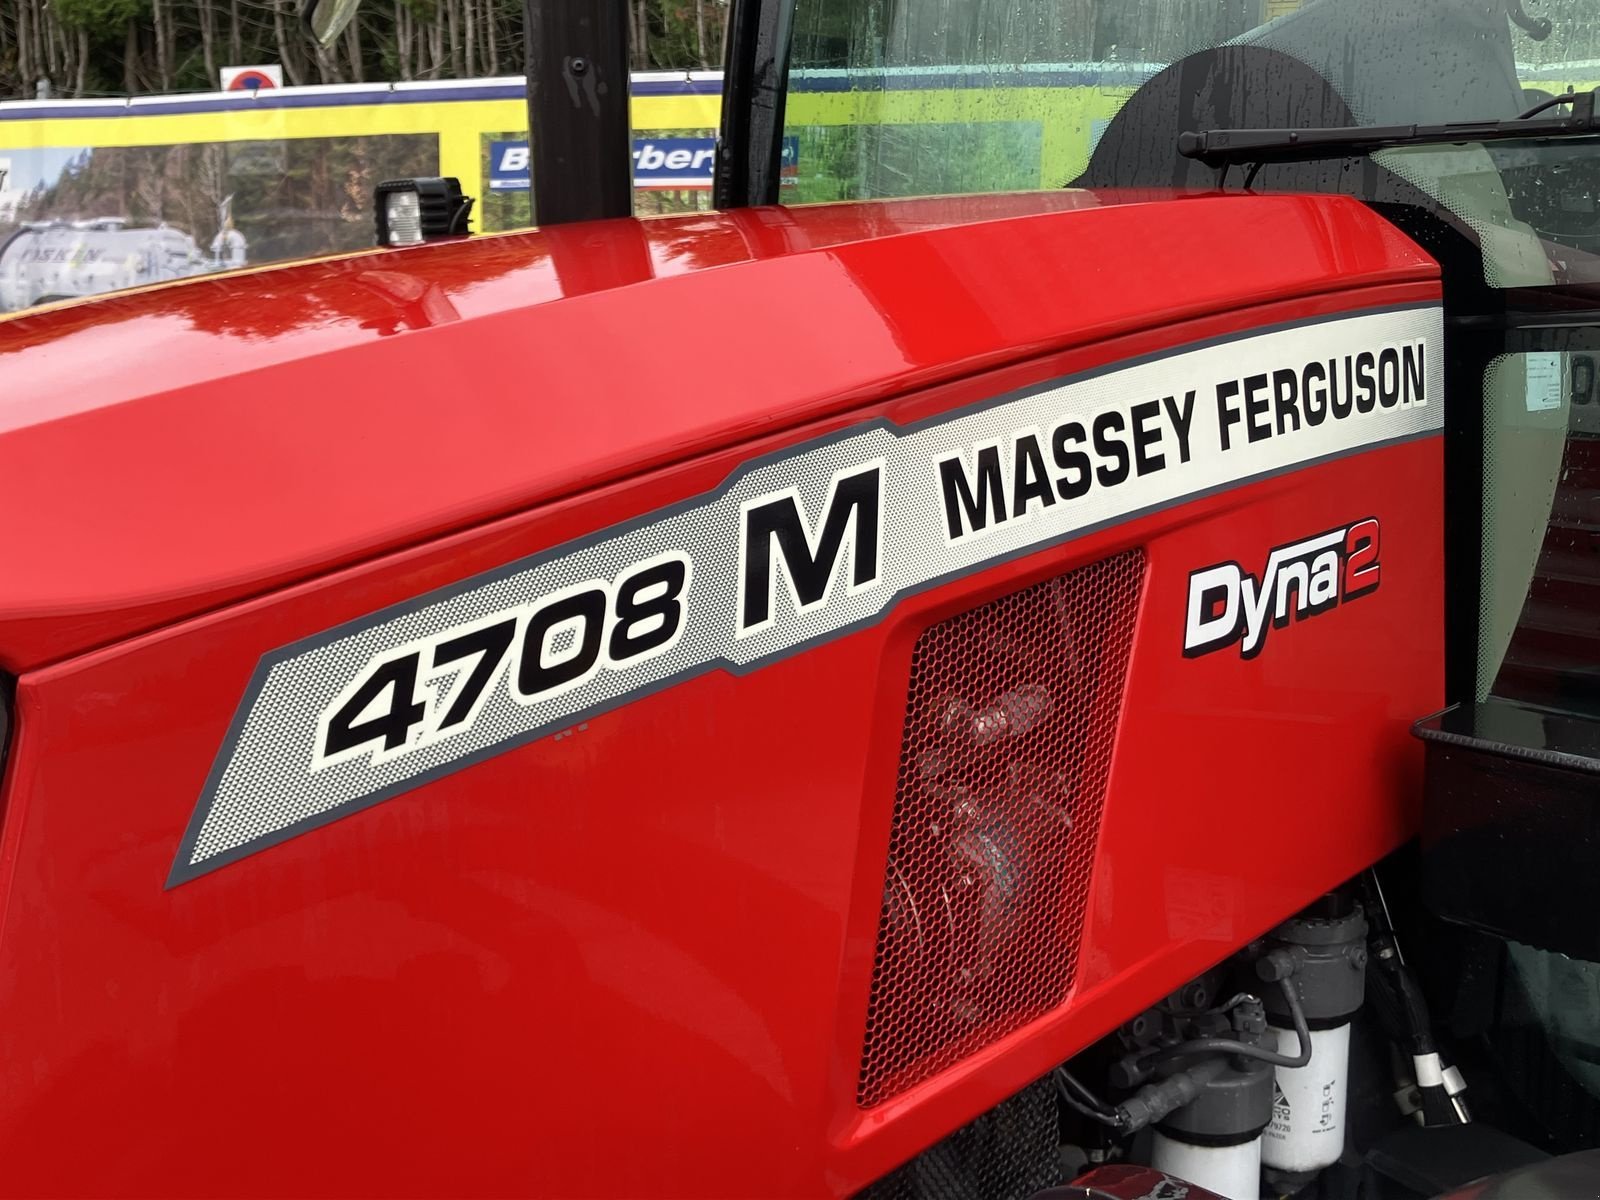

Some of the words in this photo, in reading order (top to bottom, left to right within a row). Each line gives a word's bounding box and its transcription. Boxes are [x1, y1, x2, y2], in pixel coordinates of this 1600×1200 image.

[938, 390, 1196, 540] MASSEY
[1216, 343, 1426, 452] FERGUSON
[323, 559, 686, 758] 4708
[742, 467, 881, 630] M
